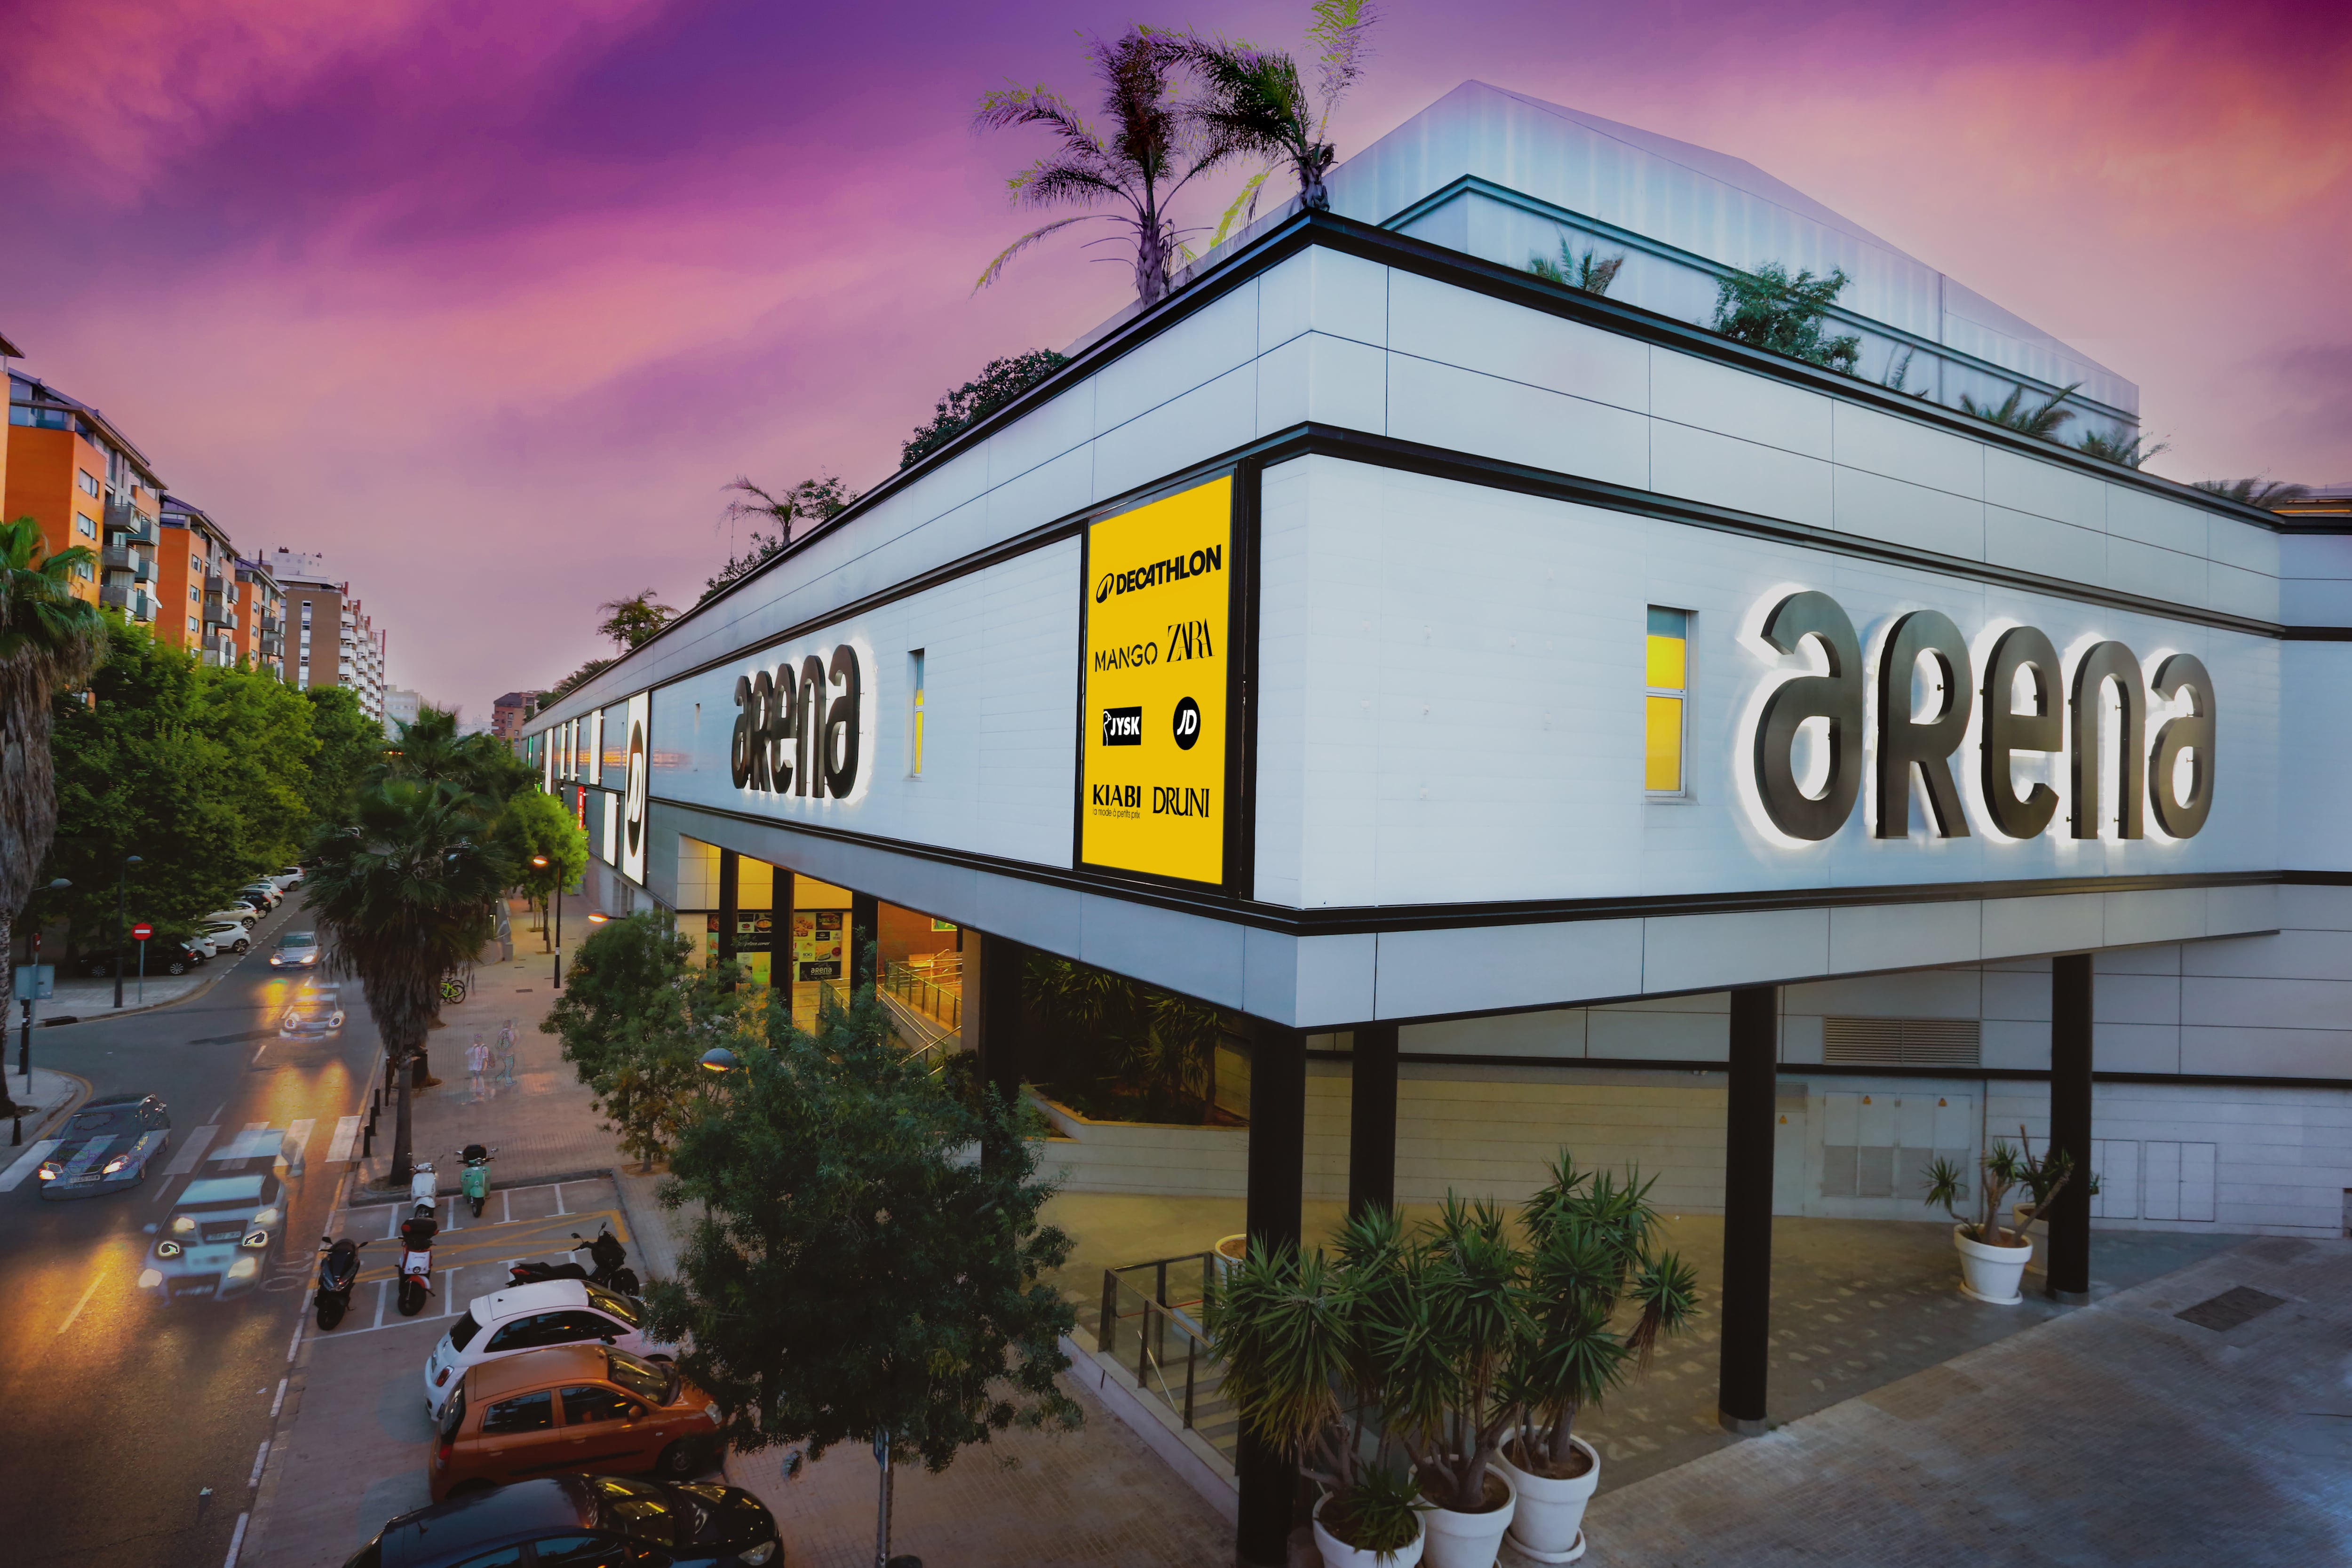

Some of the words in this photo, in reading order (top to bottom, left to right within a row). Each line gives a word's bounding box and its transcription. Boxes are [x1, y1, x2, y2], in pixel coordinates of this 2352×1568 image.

[1116, 544, 1221, 595] DECATHLON
[1167, 618, 1215, 662] ZARA
[1095, 642, 1158, 672] MANGO
[1110, 716, 1140, 736] JYSK
[1177, 709, 1197, 735] JD
[1093, 784, 1141, 808] KIABI
[1152, 787, 1210, 818] DRUNI
[1117, 810, 1130, 819] petits
[1131, 810, 1140, 820] prix
